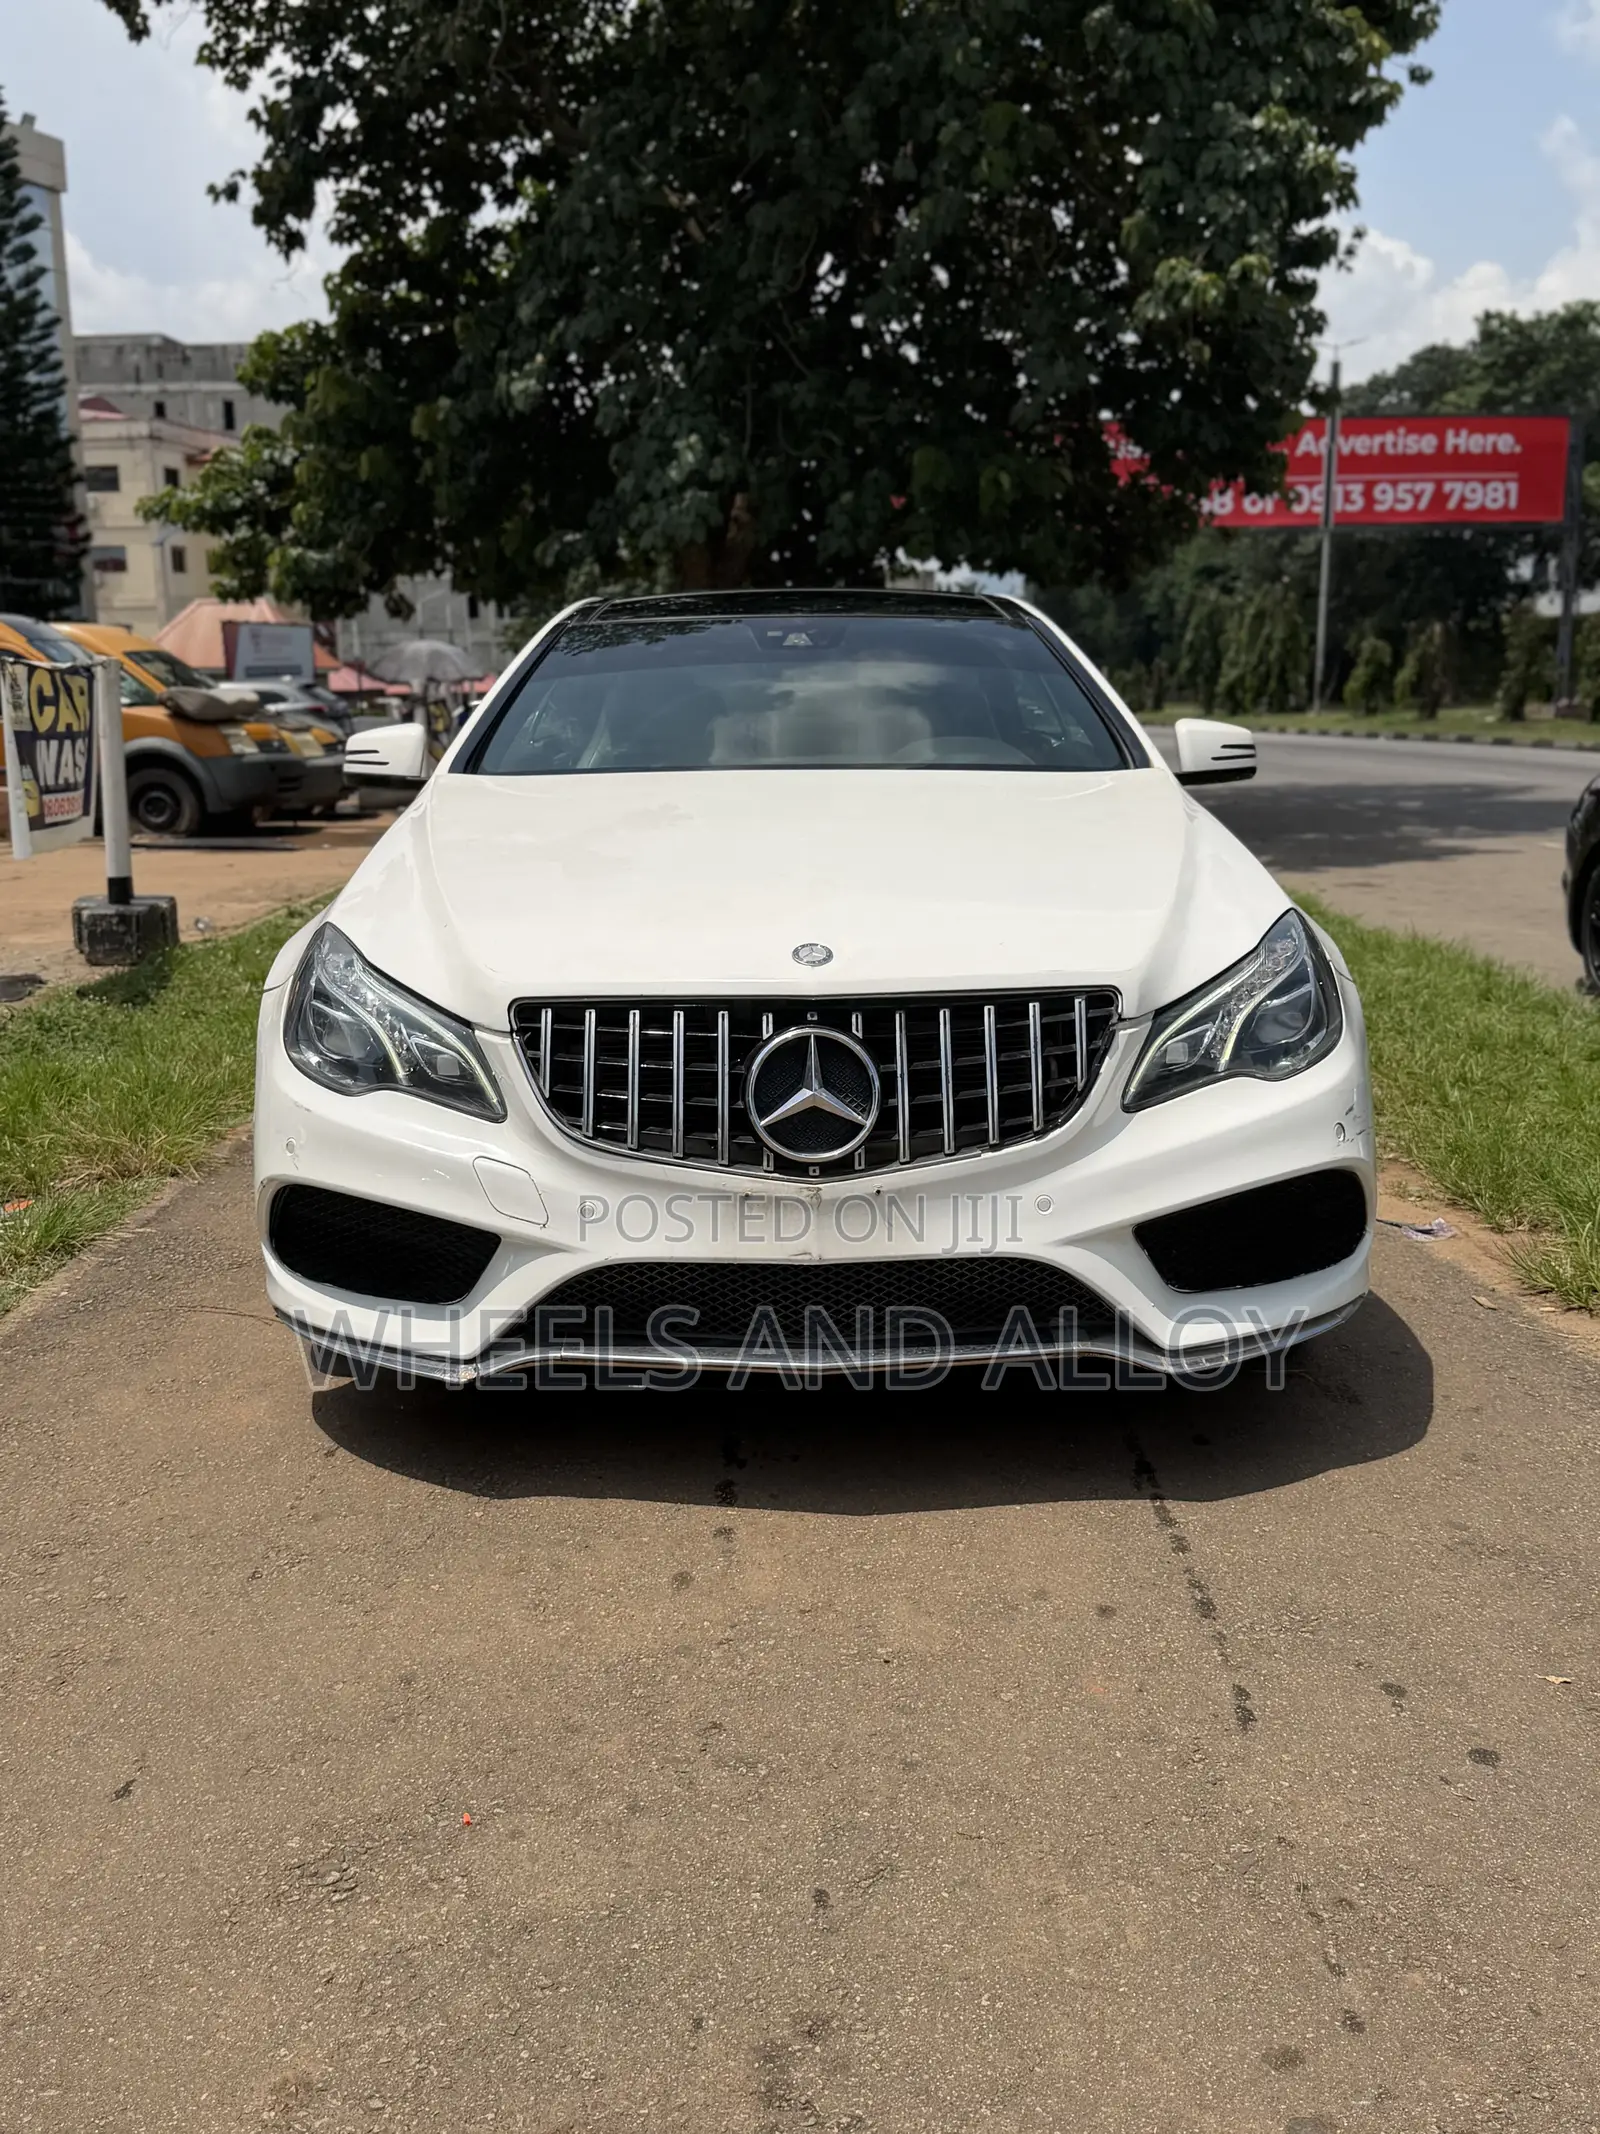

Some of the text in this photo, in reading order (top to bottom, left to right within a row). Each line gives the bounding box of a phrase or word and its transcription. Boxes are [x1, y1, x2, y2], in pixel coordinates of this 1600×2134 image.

[1445, 428, 1523, 455] Here.
[1372, 481, 1436, 513] 957
[1442, 480, 1519, 512] 7981
[30, 667, 89, 734] CAR
[35, 736, 88, 786] WAS
